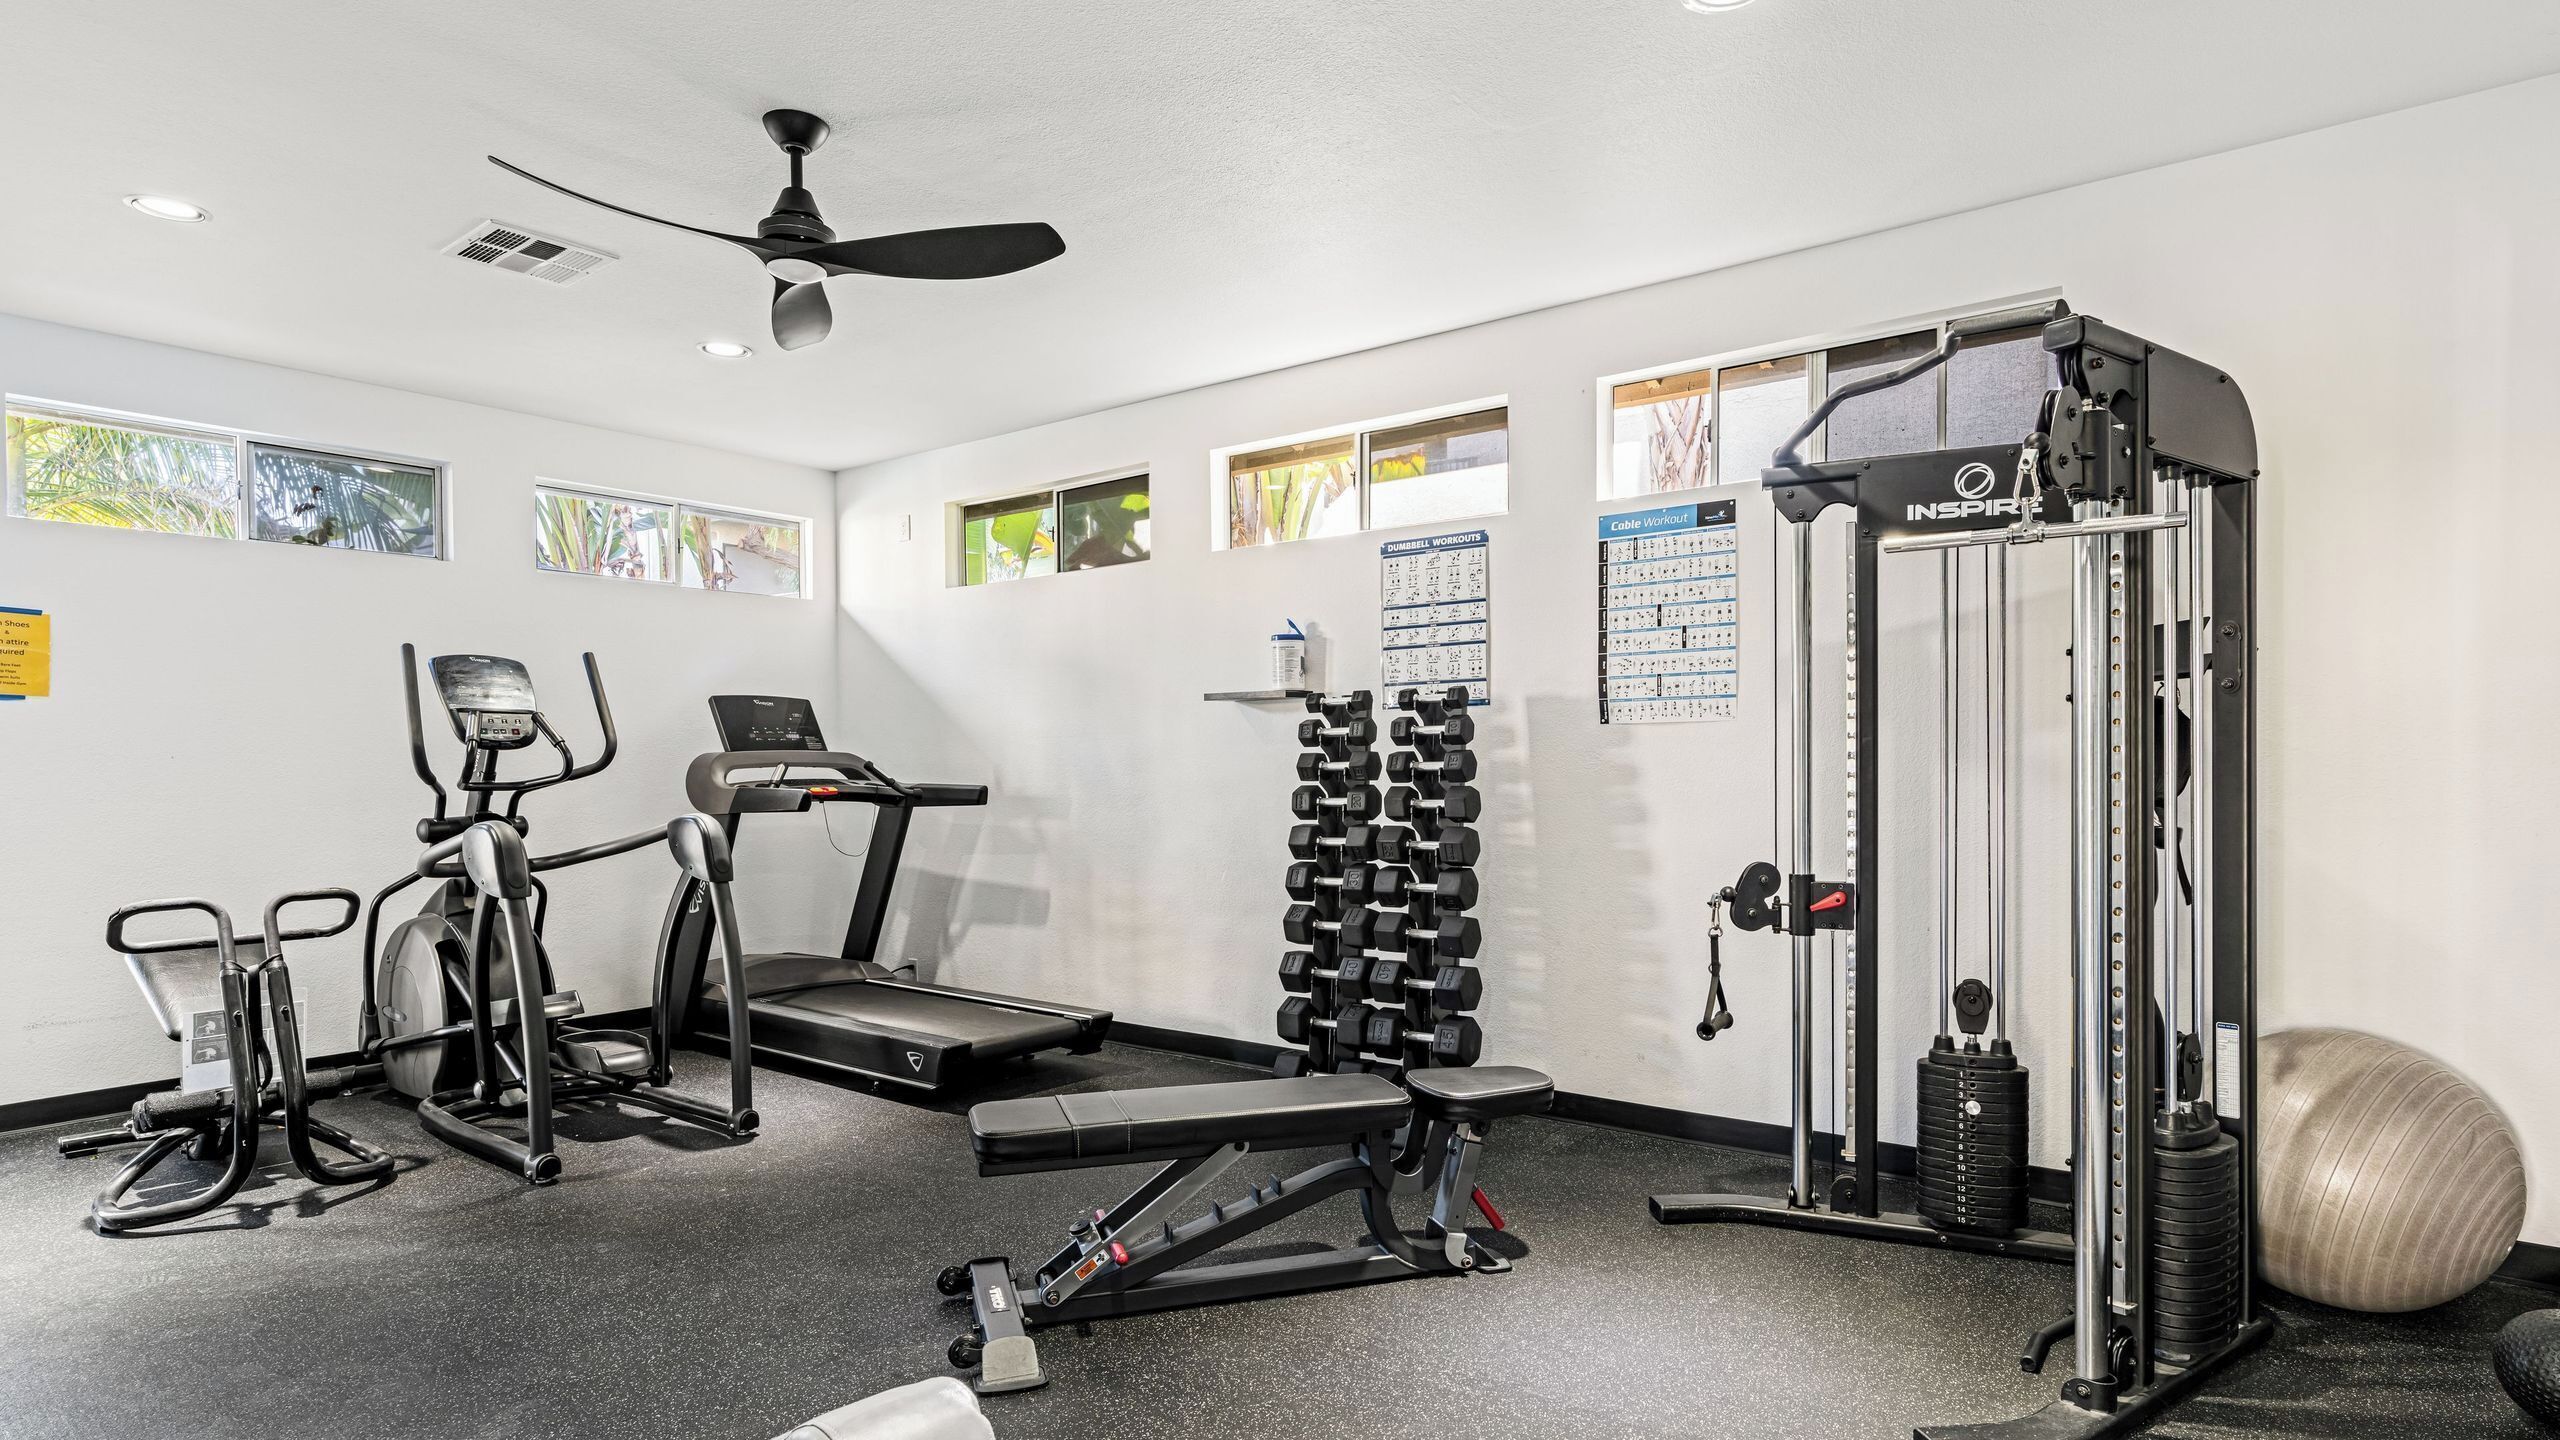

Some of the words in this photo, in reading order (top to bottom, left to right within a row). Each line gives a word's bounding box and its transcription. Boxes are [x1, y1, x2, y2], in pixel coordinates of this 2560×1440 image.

[1611, 519, 1641, 531] Cable
[1643, 513, 1688, 527] Workout
[1387, 540, 1430, 552] DUMBBELL
[1432, 533, 1481, 546] WORKOUTS
[5, 620, 30, 628] Shoes
[1450, 756, 1459, 767] 15
[1351, 795, 1361, 808] 20
[1350, 873, 1360, 887] 30
[1348, 961, 1359, 975] 40
[1379, 963, 1390, 979] 40
[1443, 1031, 1455, 1048] 45
